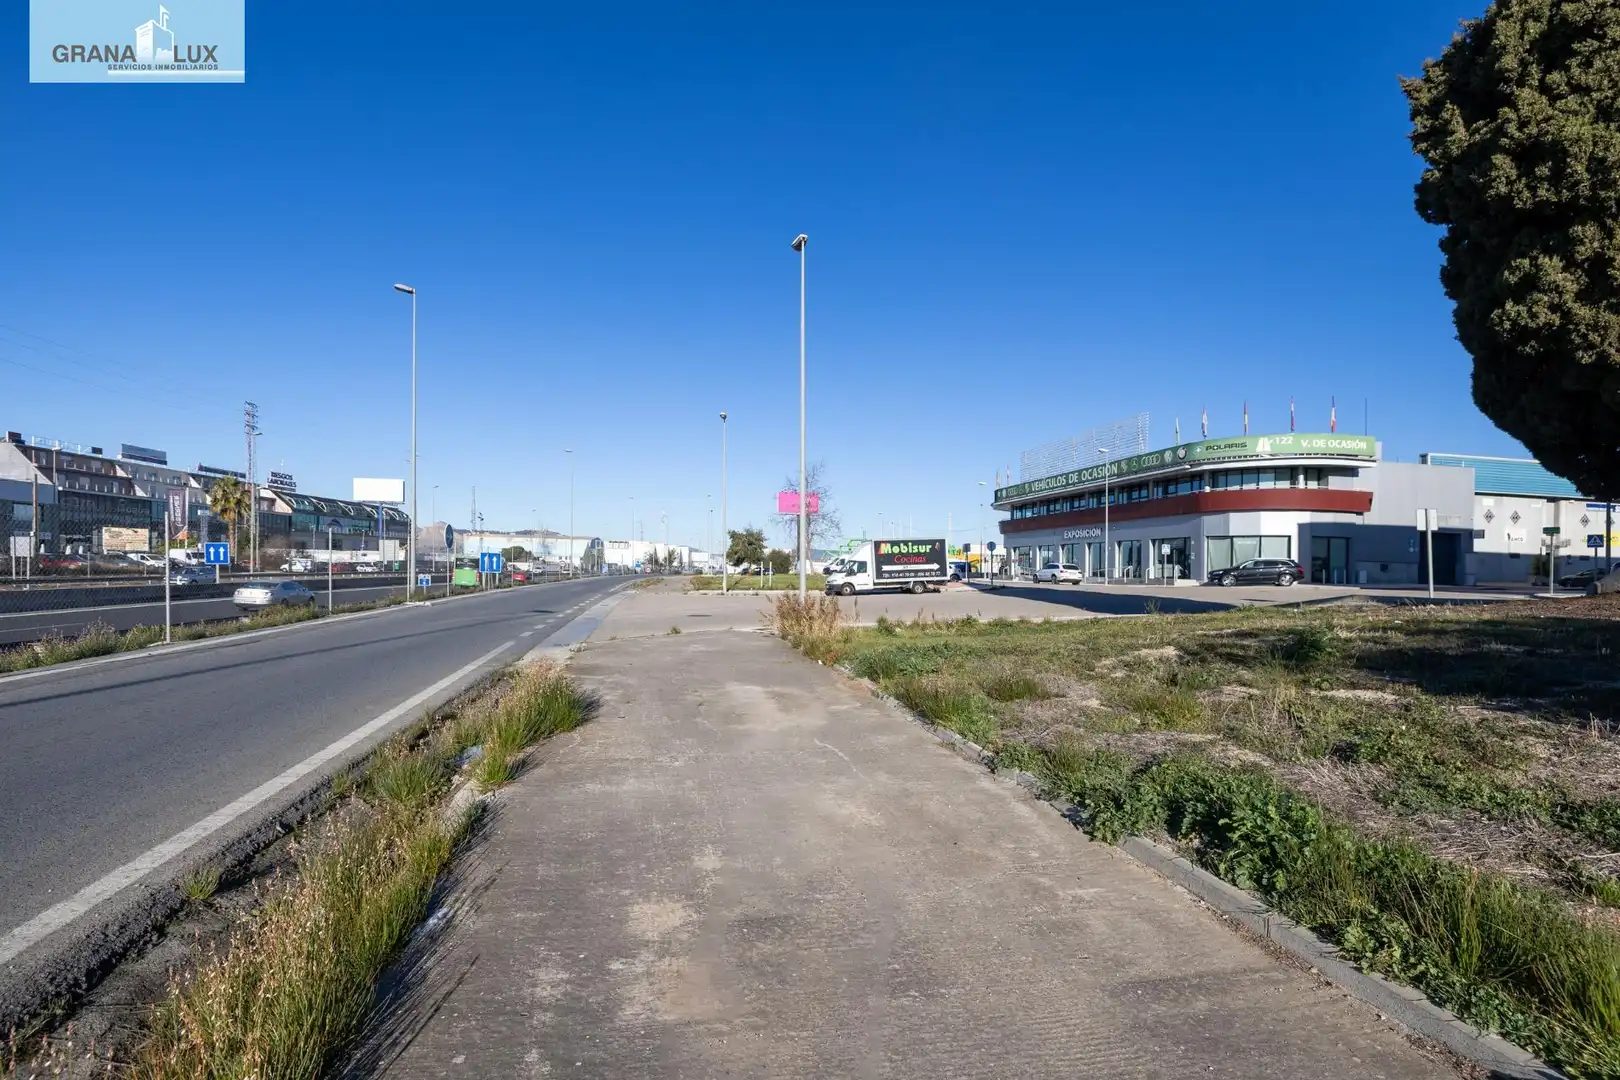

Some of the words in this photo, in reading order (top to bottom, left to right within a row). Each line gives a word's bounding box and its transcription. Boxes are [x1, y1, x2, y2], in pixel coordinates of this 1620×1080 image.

[1275, 436, 1293, 445] 122
[1300, 439, 1310, 448] V.
[1312, 439, 1326, 448] DE
[1205, 442, 1247, 451] POLARIS
[1068, 472, 1079, 484] DE
[878, 541, 932, 555] Mobisur
[894, 554, 927, 564] Cocinas
